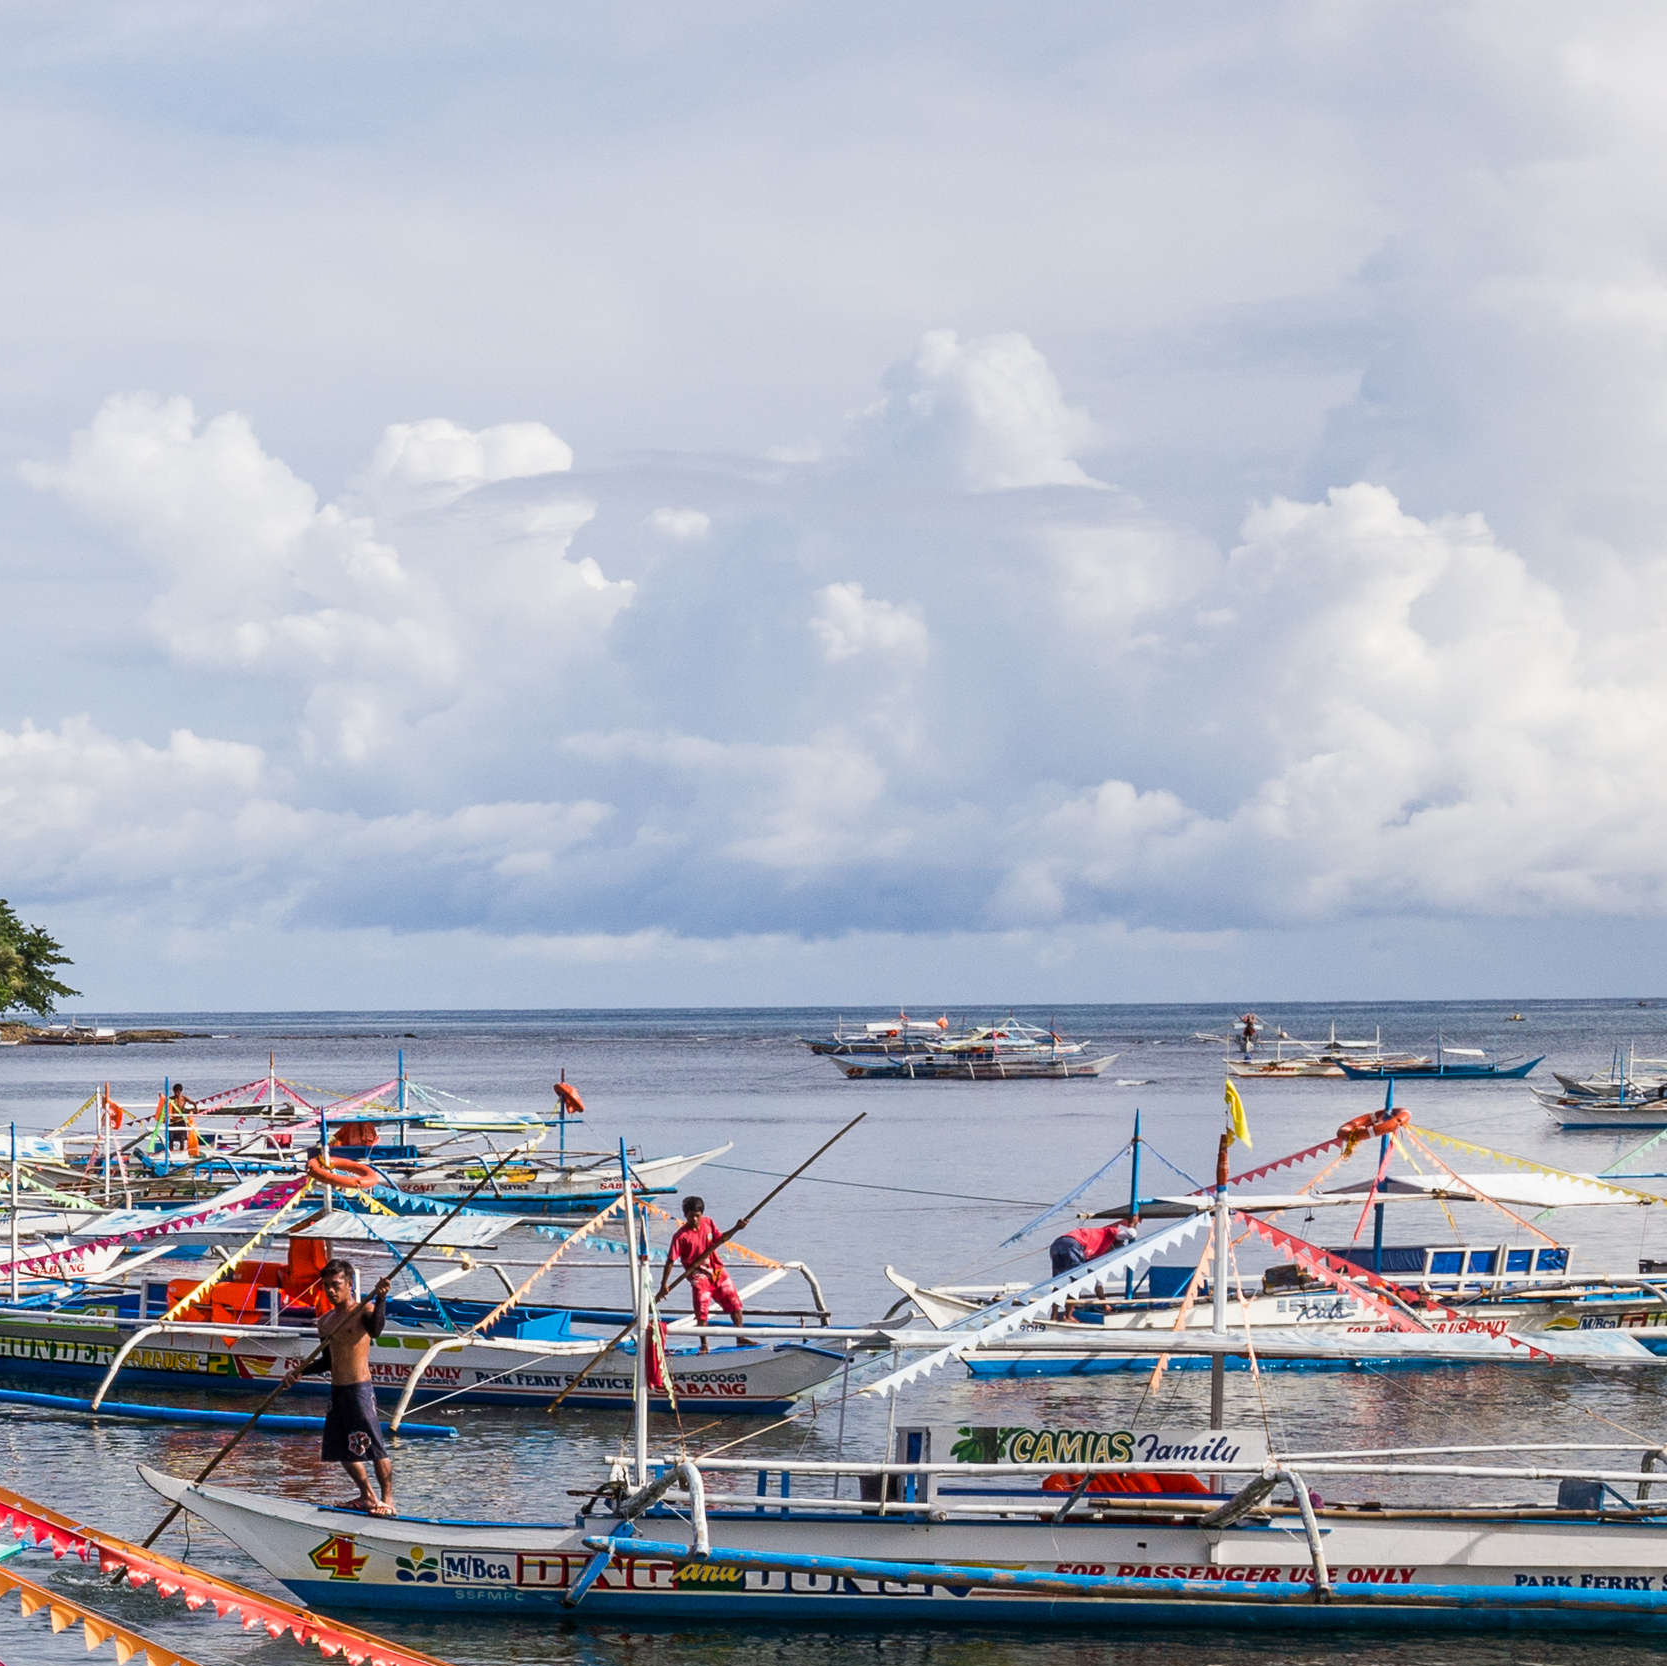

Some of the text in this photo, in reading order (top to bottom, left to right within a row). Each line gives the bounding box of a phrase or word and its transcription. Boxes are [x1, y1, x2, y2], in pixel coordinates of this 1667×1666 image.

[423, 1366, 462, 1381] ONLY
[475, 1371, 634, 1390] PARK FERRY SERVICE
[1012, 1429, 1241, 1463] CAMIAS Family
[307, 1532, 370, 1582] 4
[444, 1555, 512, 1581] M/Bca
[1114, 1564, 1283, 1584] PASSENGER
[1347, 1567, 1418, 1585] ONLY
[1514, 1574, 1573, 1588] PARK
[1580, 1574, 1656, 1592] FERRY
[454, 1589, 525, 1602] SSFMPC
